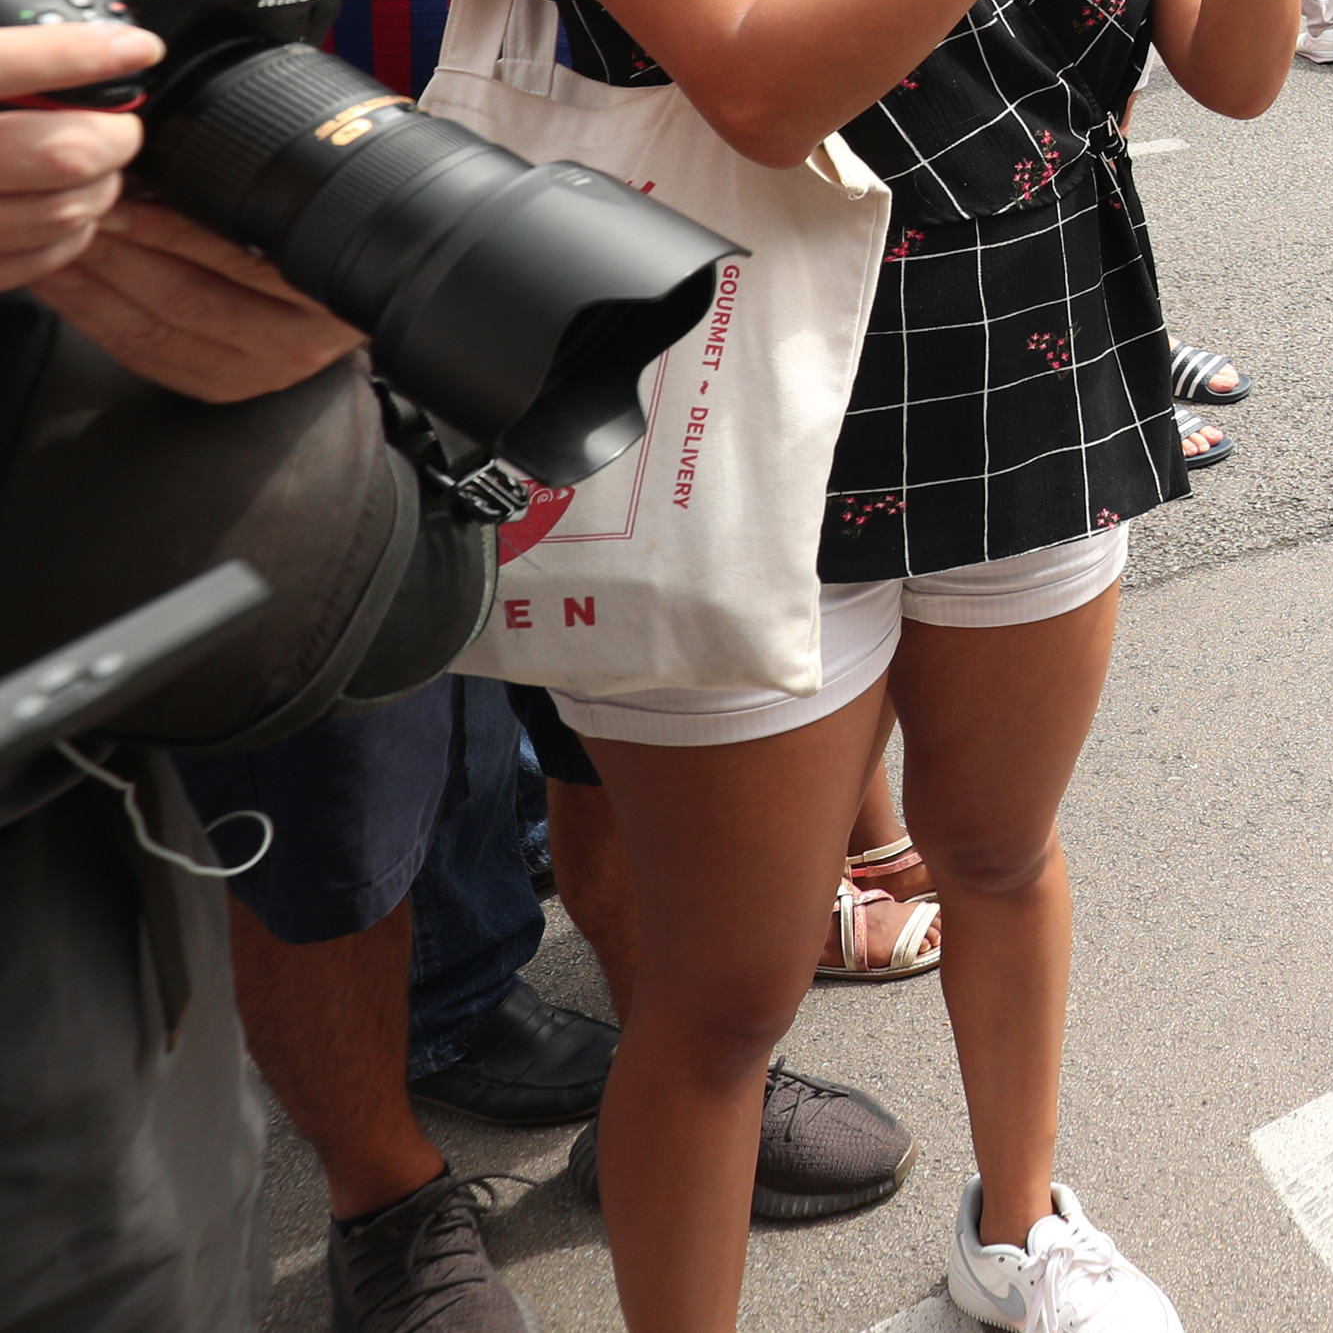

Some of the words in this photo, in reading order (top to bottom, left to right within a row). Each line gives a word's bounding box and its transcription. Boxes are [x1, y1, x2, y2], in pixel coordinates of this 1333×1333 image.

[703, 264, 739, 371] GOURMET
[672, 406, 708, 510] DELIVERY
[505, 596, 597, 629] EN
